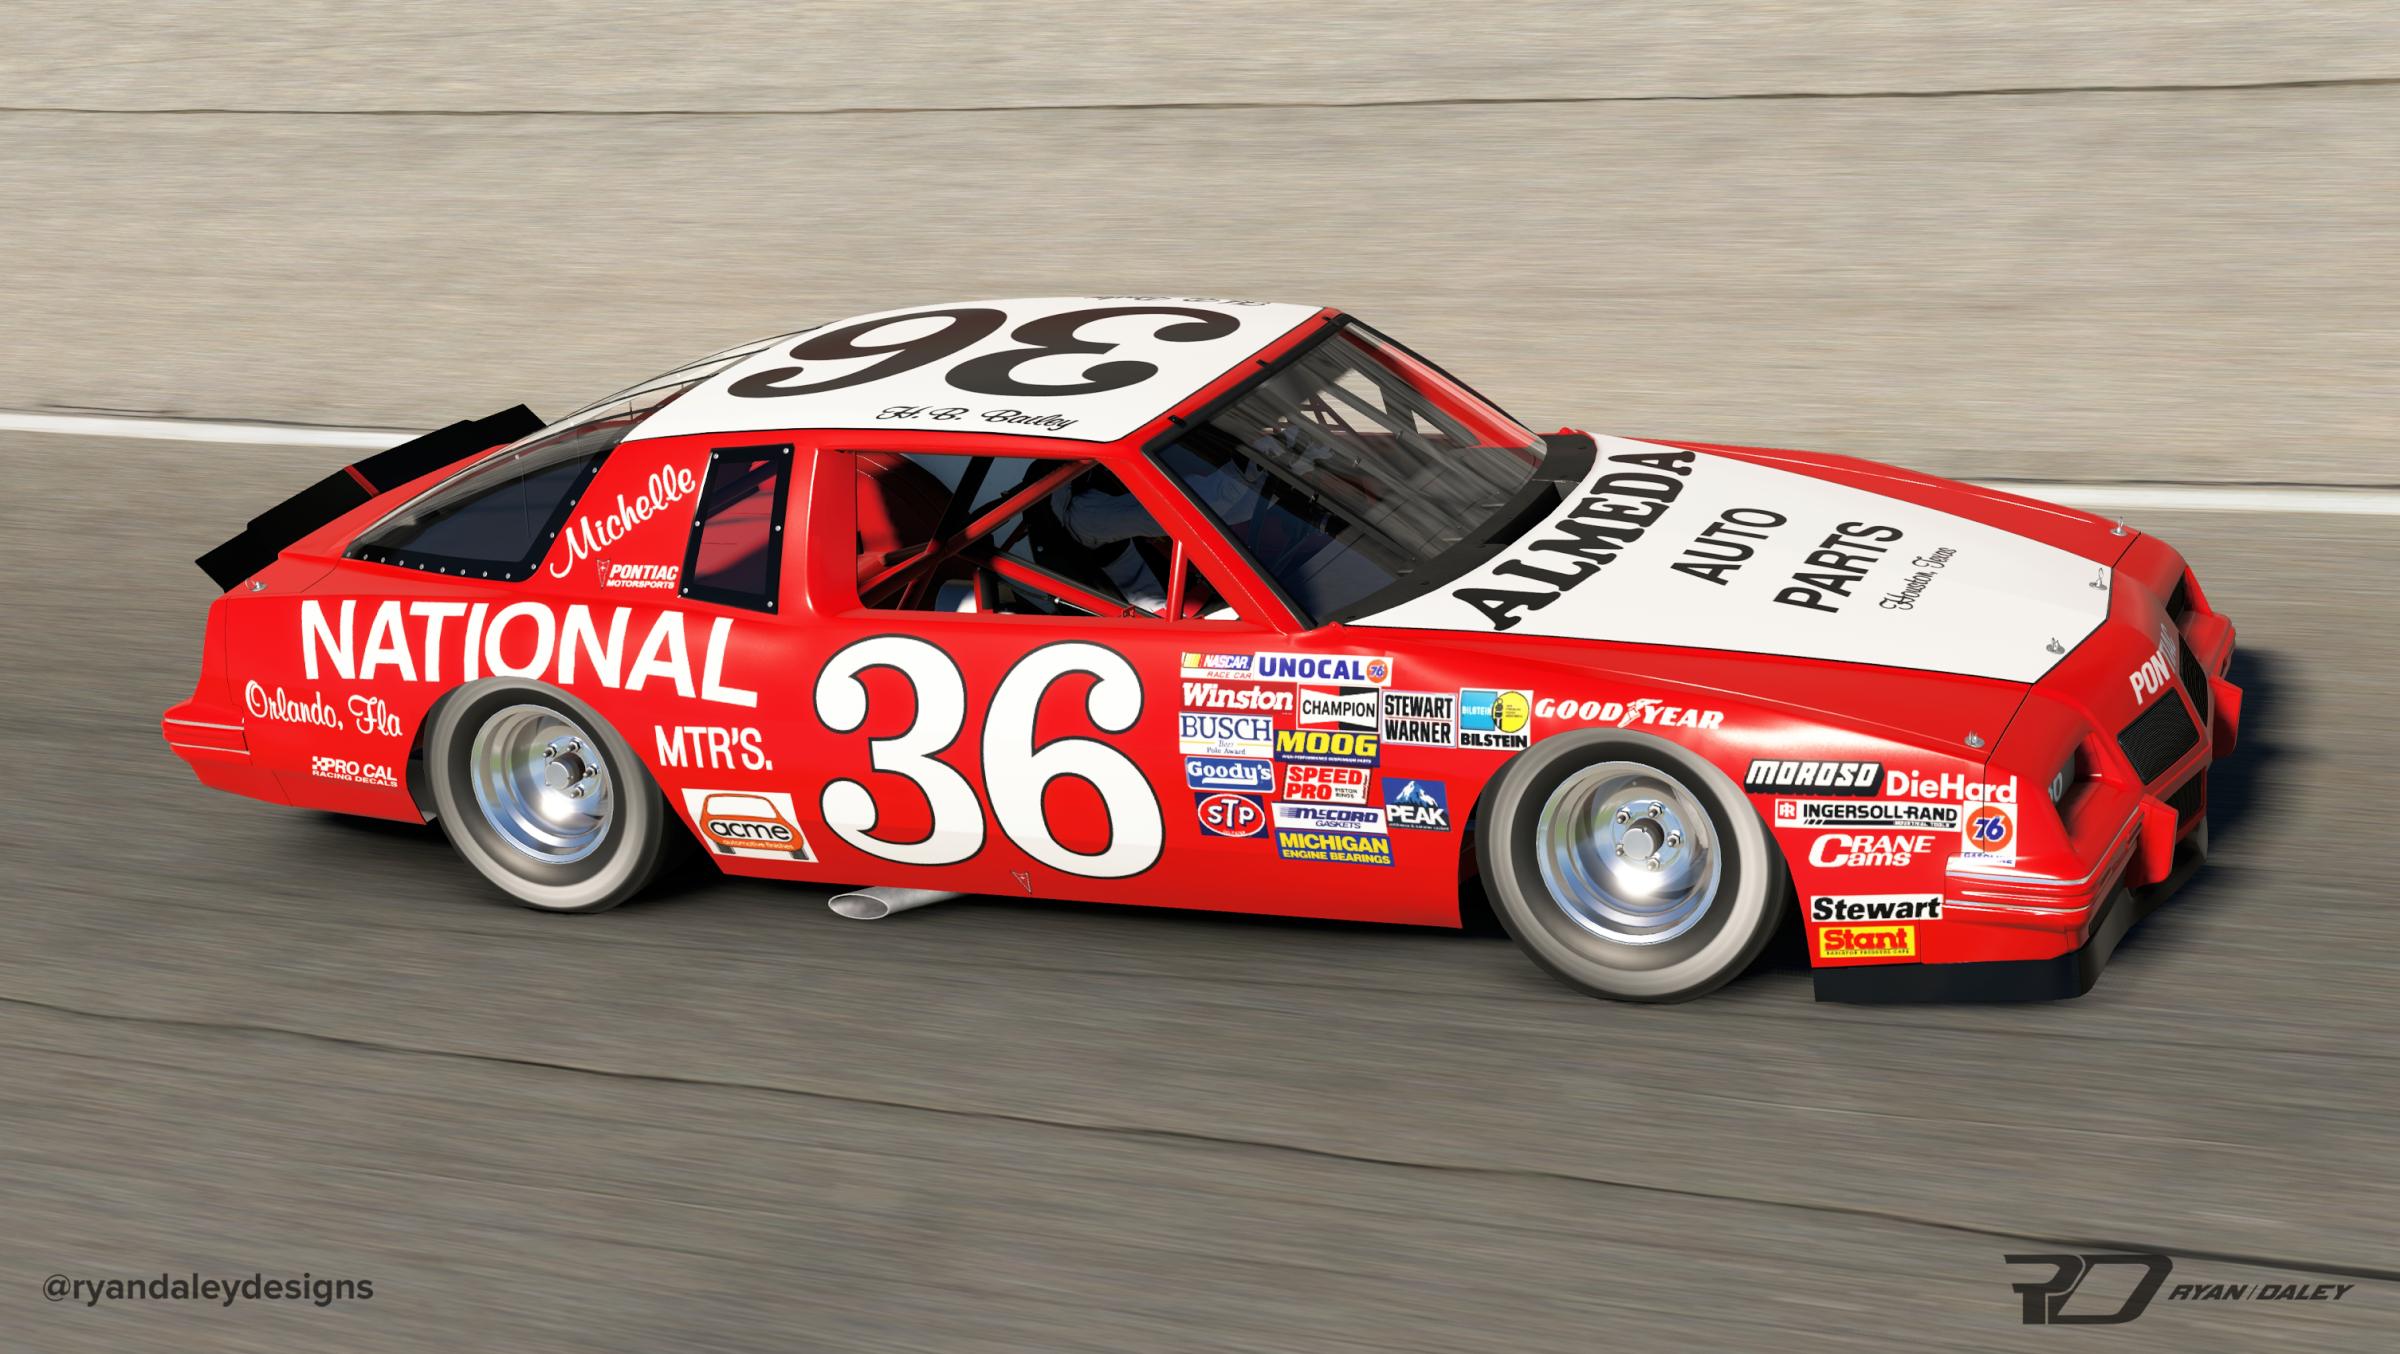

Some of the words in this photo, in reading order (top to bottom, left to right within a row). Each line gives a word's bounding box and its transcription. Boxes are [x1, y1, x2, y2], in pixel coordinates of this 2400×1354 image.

[981, 409, 1079, 431] Bailey
[550, 464, 696, 579] Michelle
[1452, 450, 1697, 631] ALMEDA
[1670, 507, 1788, 586] AUTO
[609, 564, 679, 580] PONTIAC
[1772, 521, 1904, 614] PARTS
[606, 579, 675, 589] MOTORSPORTS
[300, 600, 758, 708] NATIONAL
[1203, 654, 1249, 669] NASCAR
[1259, 657, 1365, 680] UNOCAL
[1368, 664, 1385, 677] 76
[245, 679, 343, 730] Orlando,
[348, 694, 403, 737] Fla
[1182, 682, 1294, 711] Winston
[1302, 699, 1376, 718] CHAMPION
[1384, 694, 1453, 719] STEWART
[1180, 715, 1272, 741] BUSCH
[1384, 719, 1451, 744] WARNER
[654, 725, 773, 771] MTR'S.
[1276, 730, 1378, 757] MOOG
[1460, 733, 1528, 748] BILSTEIN
[812, 633, 1166, 880] 36
[312, 770, 352, 781] RACING
[355, 775, 398, 788] DECALS
[324, 758, 360, 776] PRO
[363, 763, 398, 781] CAL
[1187, 761, 1272, 785] Goody's
[1288, 766, 1363, 785] SPEED
[1745, 760, 1882, 791] MOROSO
[1286, 782, 1332, 800] PRO
[1886, 770, 2018, 803] DieHard
[1207, 799, 1256, 828] STP
[1315, 820, 1361, 829] GASKETS
[1385, 804, 1447, 826] PEAK
[1803, 804, 1958, 821] INGERSOLL-RAND
[710, 821, 790, 840] acme
[1973, 815, 2006, 841] 76
[1279, 832, 1389, 854] MICHIGAN
[1808, 833, 1936, 867] CRANE
[1282, 849, 1328, 860] ENGINE
[1330, 851, 1391, 864] BEARINGS
[1813, 896, 1940, 921] Stewart
[1823, 928, 1908, 950] Stant
